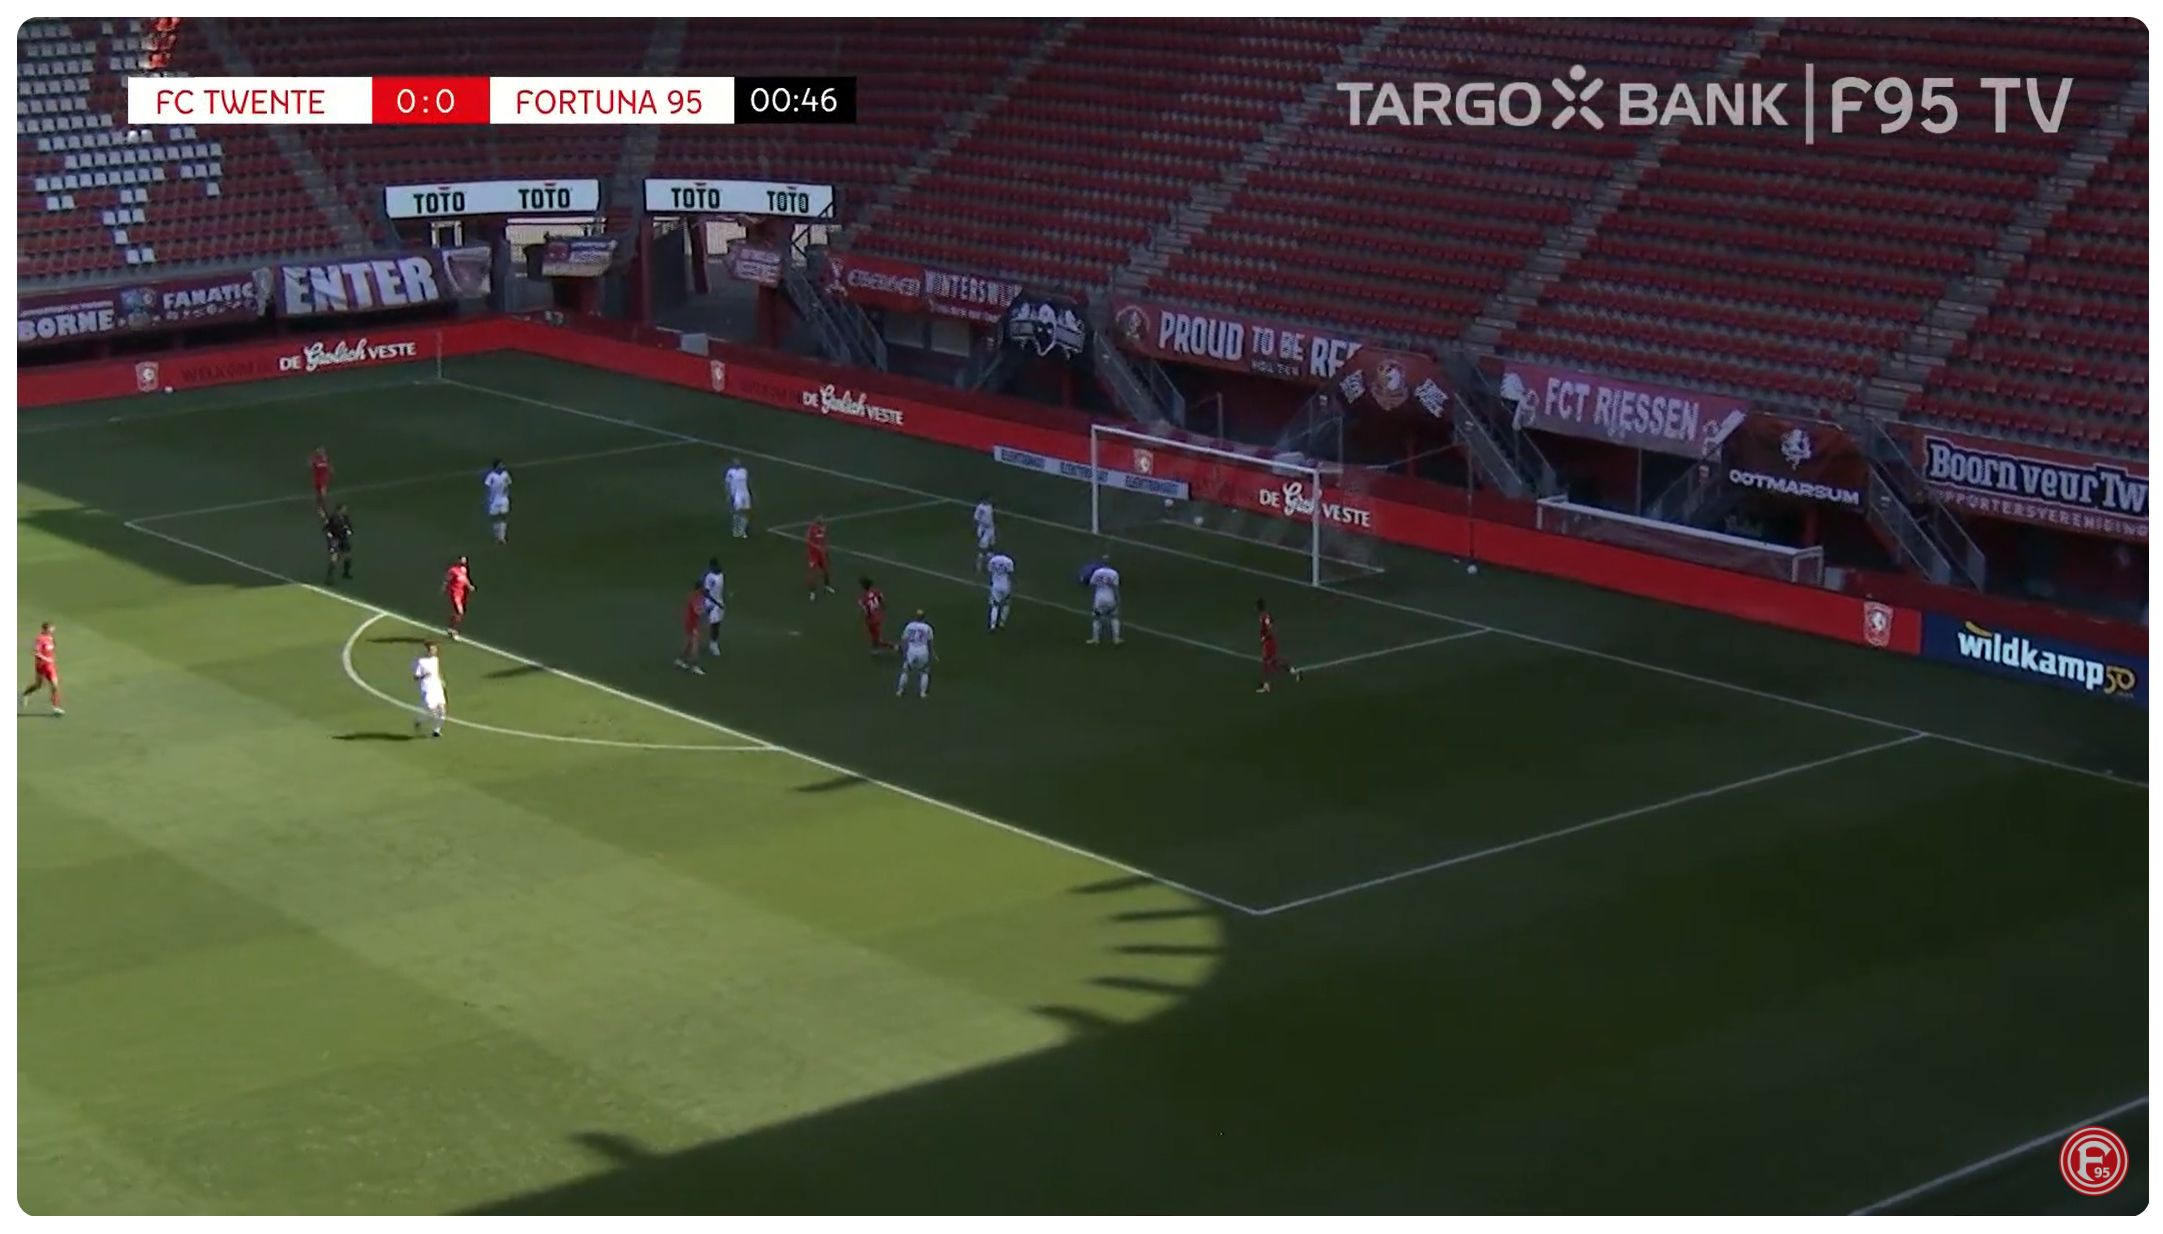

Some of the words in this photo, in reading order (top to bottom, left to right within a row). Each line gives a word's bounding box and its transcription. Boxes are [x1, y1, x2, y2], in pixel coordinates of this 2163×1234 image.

[413, 191, 465, 214] TOTO
[518, 188, 571, 210] TOTO
[671, 187, 720, 209] TOTO
[766, 190, 809, 213] TOTO
[282, 256, 440, 315] ENTER
[17, 308, 115, 342] BORNE
[279, 355, 300, 371] DE
[369, 342, 417, 360] VESTE
[1158, 309, 1246, 362] PROUD
[1251, 325, 1275, 356] TO
[1280, 330, 1306, 361] BE
[1309, 335, 1363, 378] RE
[802, 390, 820, 408] DE
[866, 405, 905, 426] VESTE
[1544, 377, 1591, 423] FCT
[1728, 468, 1860, 505] OOTMARSUM
[1928, 440, 2018, 491] Boorn
[2019, 463, 2099, 502] veur
[1258, 488, 1282, 508] DE
[1321, 502, 1371, 528] VESTE
[1956, 631, 2105, 691] wildkamp
